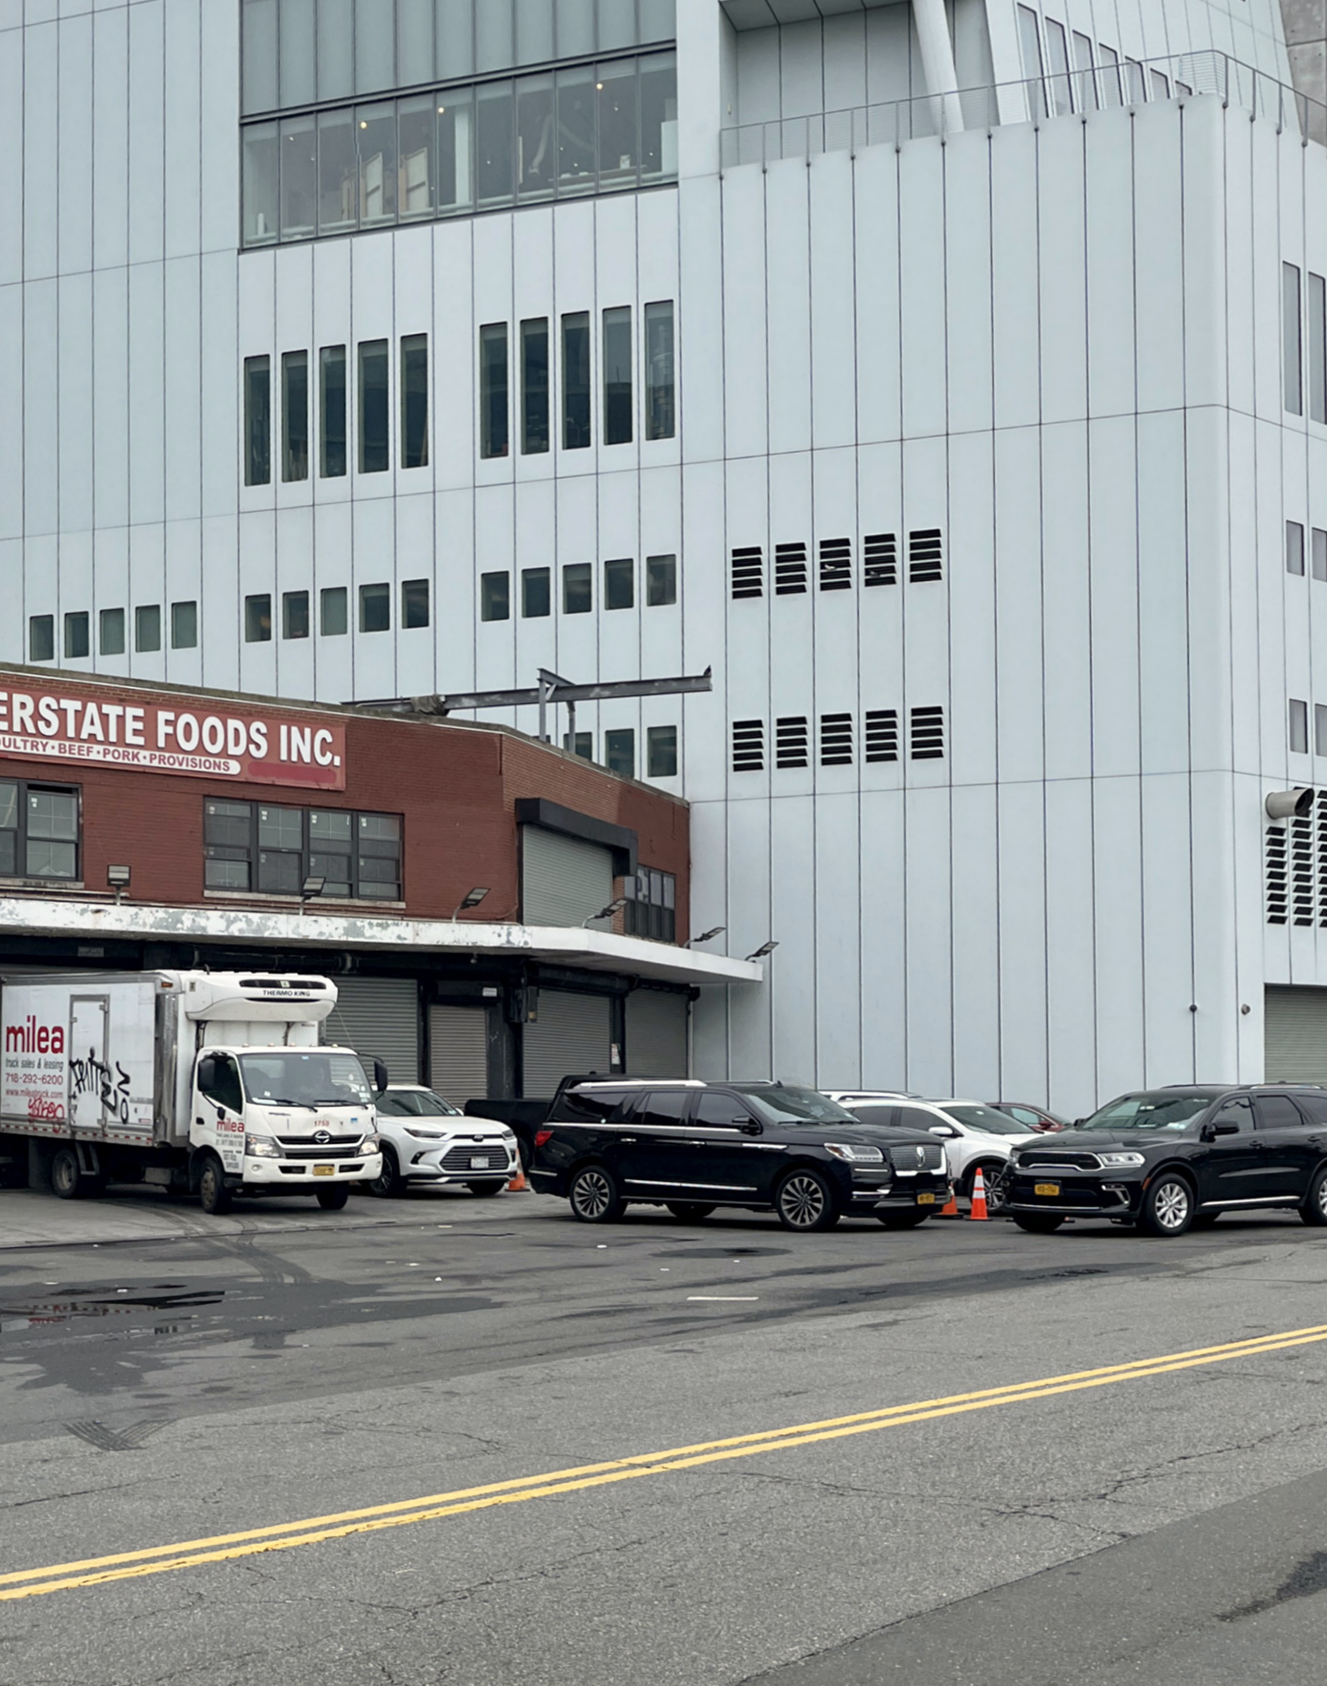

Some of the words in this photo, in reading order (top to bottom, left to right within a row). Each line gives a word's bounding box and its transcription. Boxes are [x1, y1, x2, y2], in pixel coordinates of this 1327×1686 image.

[157, 710, 269, 759] FOODS
[279, 724, 341, 767] INC.
[58, 743, 95, 757] BEEF
[102, 748, 141, 763] PORK
[149, 753, 231, 772] PROVISIONS
[262, 989, 293, 997] THERMO
[5, 1014, 65, 1054] milea
[5, 1057, 19, 1068] truck
[21, 1058, 35, 1069] sales
[43, 1058, 64, 1073] leasing
[5, 1072, 64, 1085] 718-292-6200
[216, 1117, 245, 1133] milea
